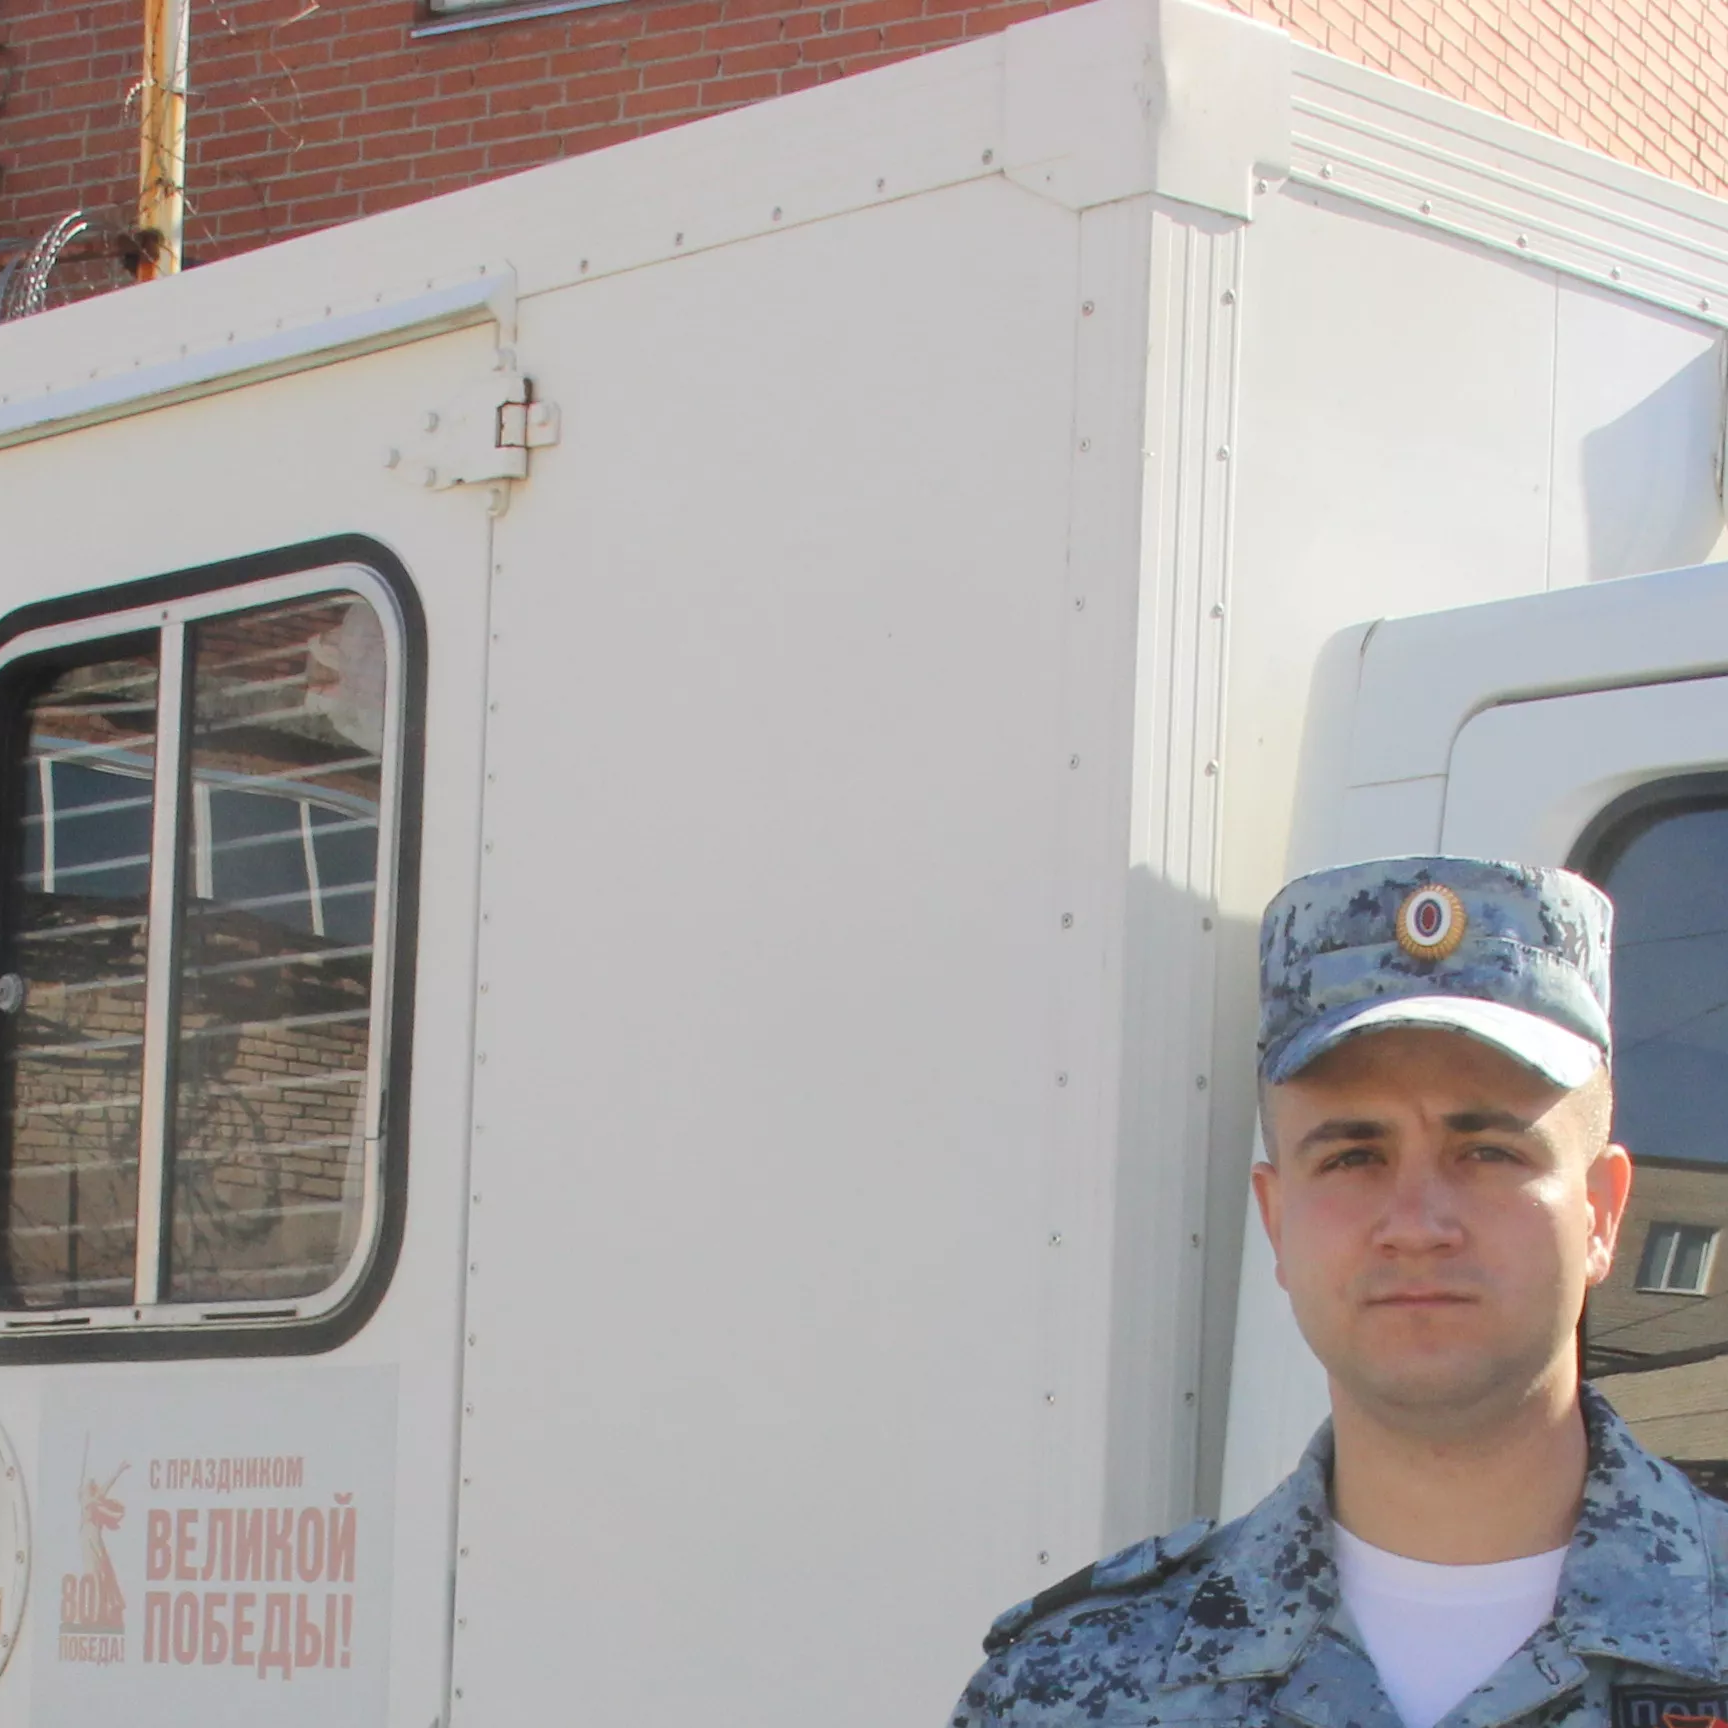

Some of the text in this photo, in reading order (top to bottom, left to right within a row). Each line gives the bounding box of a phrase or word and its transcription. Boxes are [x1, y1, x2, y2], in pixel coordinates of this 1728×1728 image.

[149, 1456, 305, 1494] С ПРАЗДНИКОМ
[145, 1491, 358, 1584] ВЕЛИКОЙ
[142, 1590, 354, 1682] ПОБЕДЫ!
